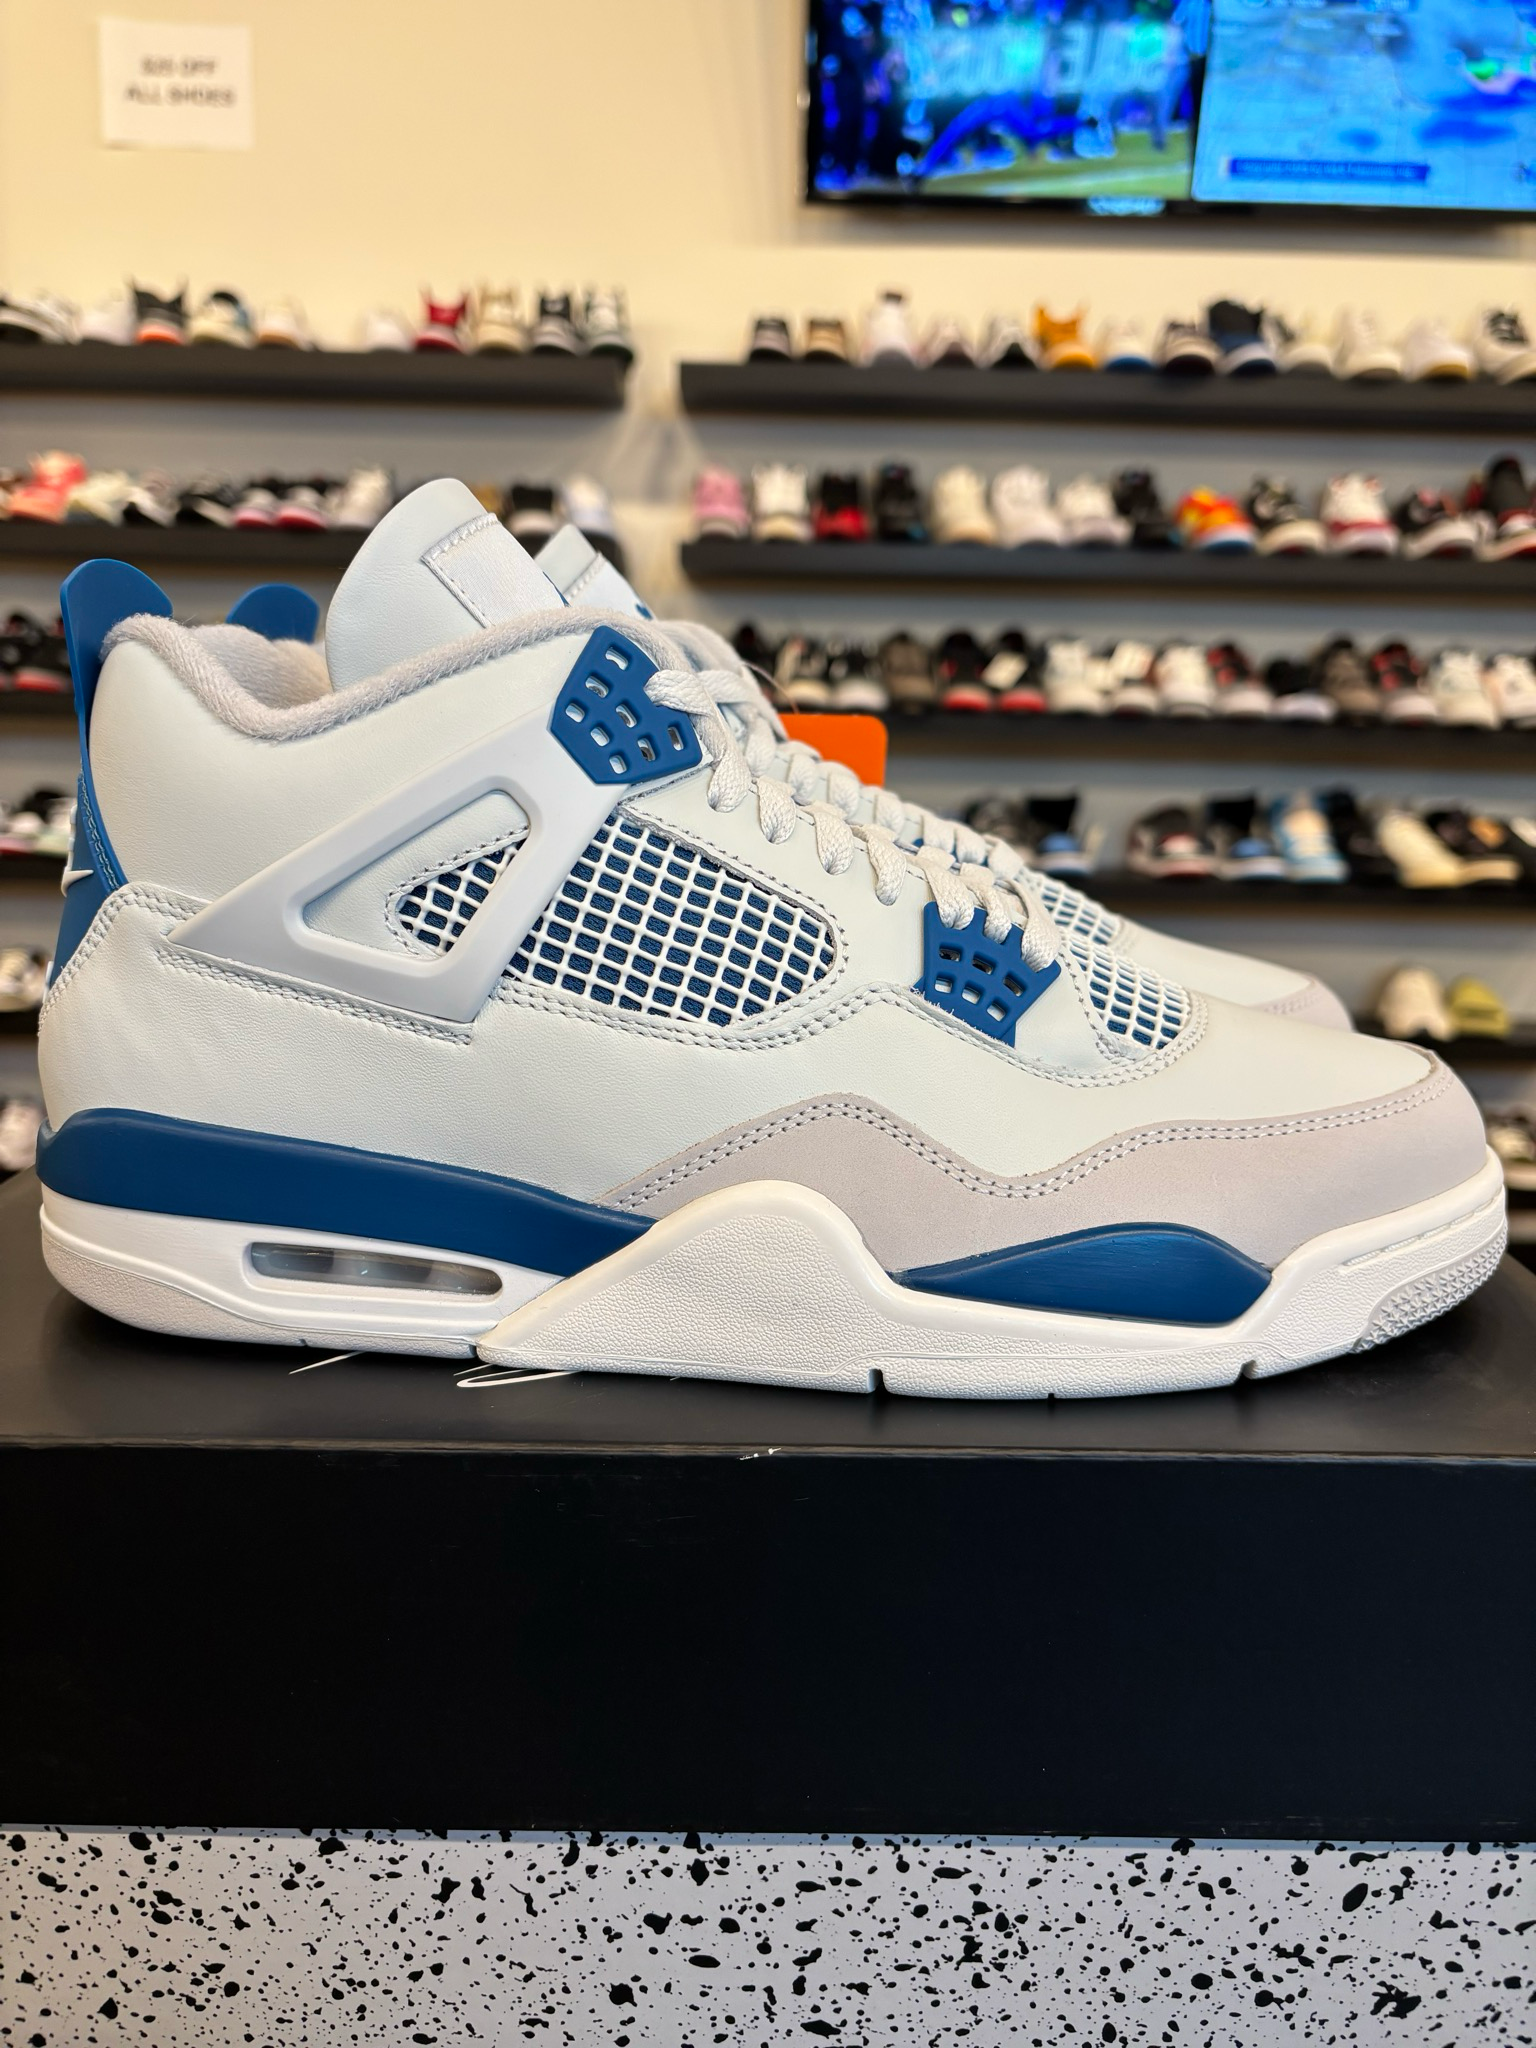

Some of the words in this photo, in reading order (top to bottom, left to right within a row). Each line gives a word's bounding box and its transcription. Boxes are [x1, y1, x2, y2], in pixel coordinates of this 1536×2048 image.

[179, 57, 217, 77] OFF
[125, 82, 161, 105] ALL
[166, 82, 234, 108] SHOES
